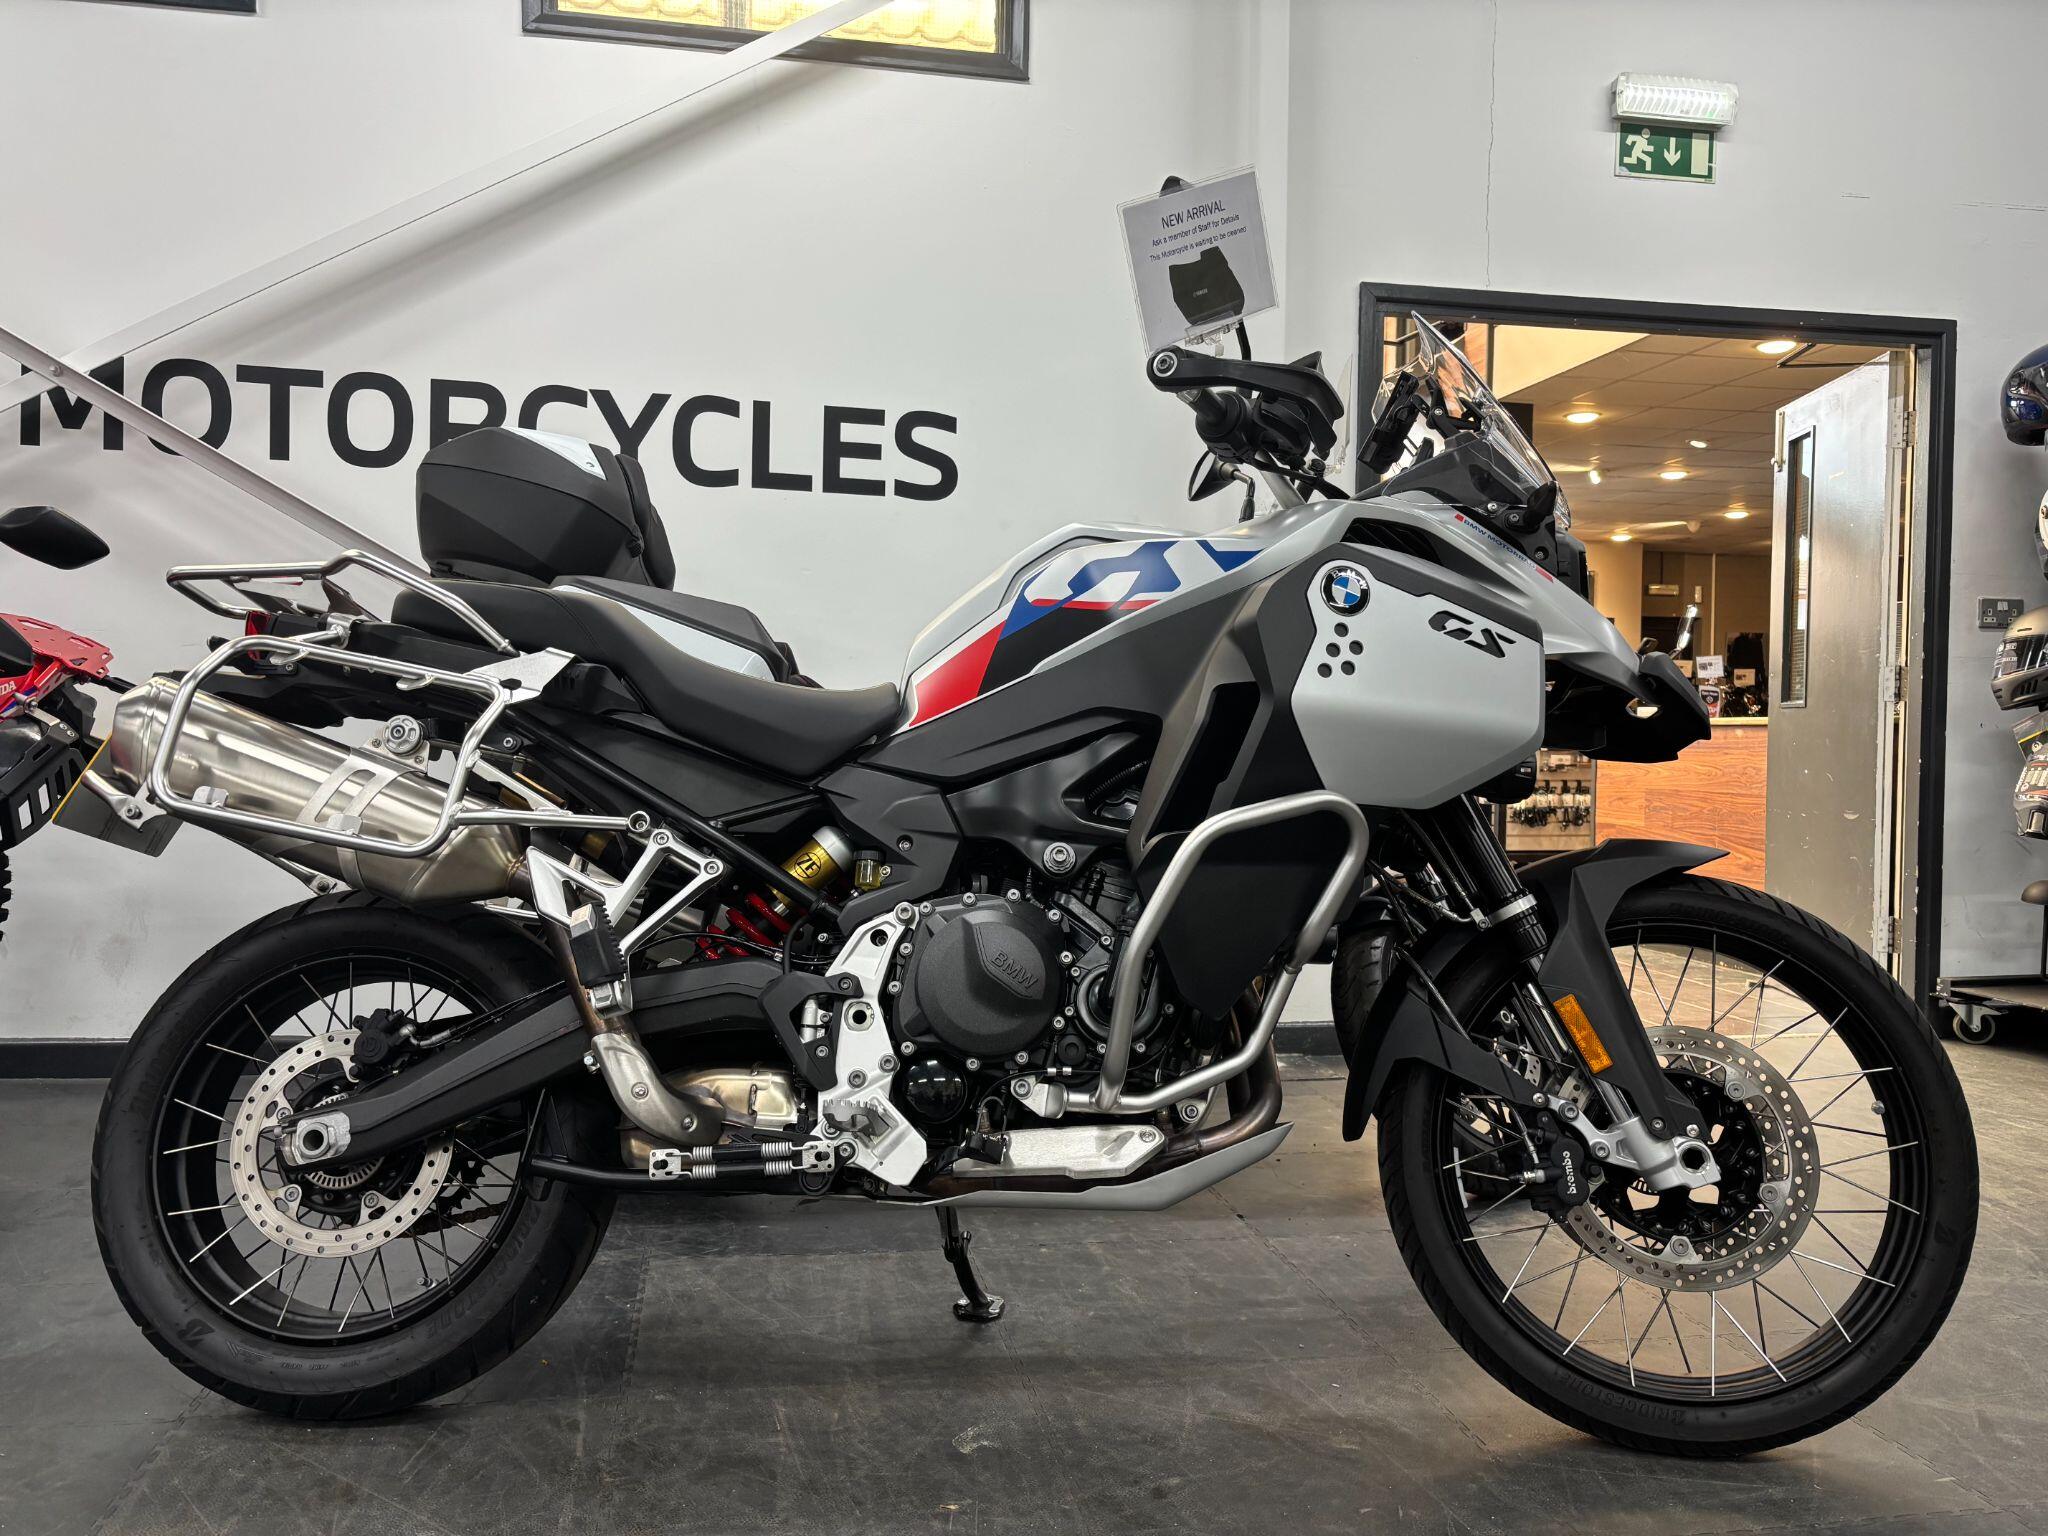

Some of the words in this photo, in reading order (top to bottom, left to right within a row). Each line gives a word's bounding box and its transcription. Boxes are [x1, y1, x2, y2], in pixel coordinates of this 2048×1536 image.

[1152, 237, 1163, 247] Ask
[1168, 229, 1191, 243] member
[1197, 222, 1211, 233] Staff
[1212, 219, 1220, 228] for
[1220, 213, 1240, 226] Details
[1161, 211, 1184, 229] NEW
[1187, 200, 1226, 222] ARRIVAL
[1149, 253, 1161, 263] This
[1161, 245, 1189, 258] Motorcycle
[1227, 226, 1247, 238] cleaned
[1464, 519, 1487, 535] BMW
[1428, 610, 1516, 658] GS
[991, 950, 1038, 991] BMW
[1562, 1150, 1577, 1194] brembo
